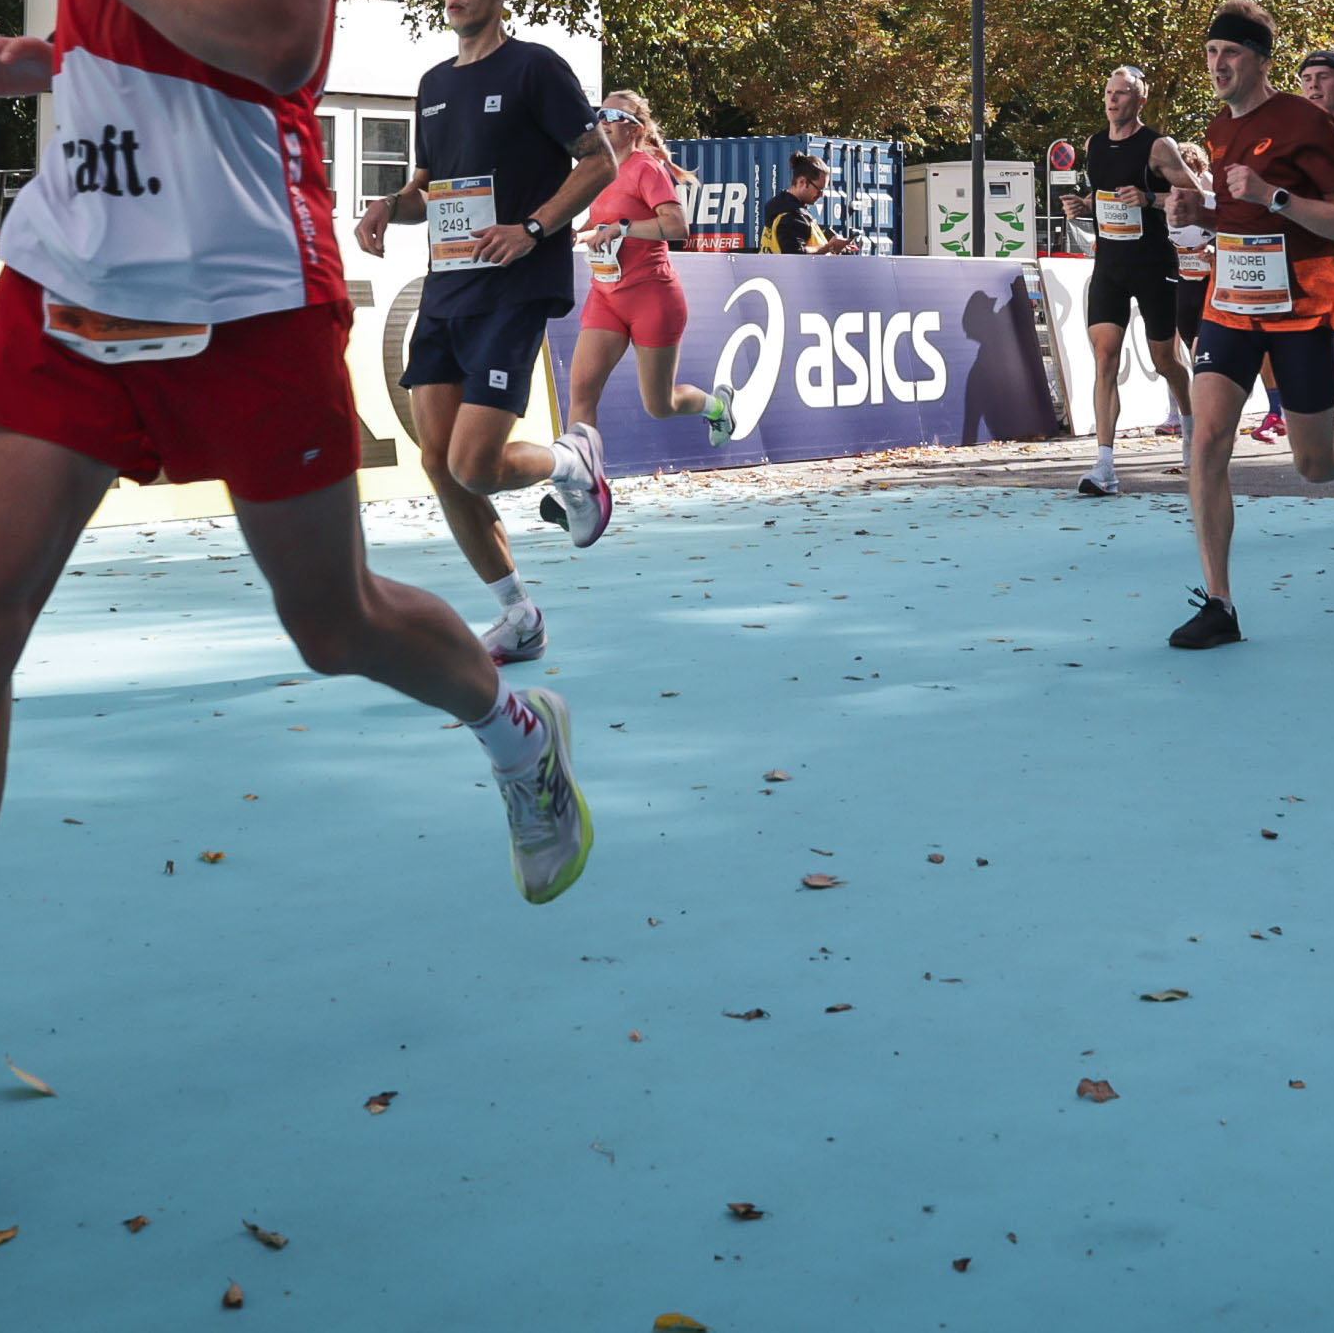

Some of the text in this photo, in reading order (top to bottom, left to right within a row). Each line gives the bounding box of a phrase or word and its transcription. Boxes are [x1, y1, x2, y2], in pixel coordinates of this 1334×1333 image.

[439, 201, 465, 215] STIG
[675, 182, 748, 225] NER
[1227, 255, 1266, 266] ANDREI
[1229, 269, 1267, 282] 24096
